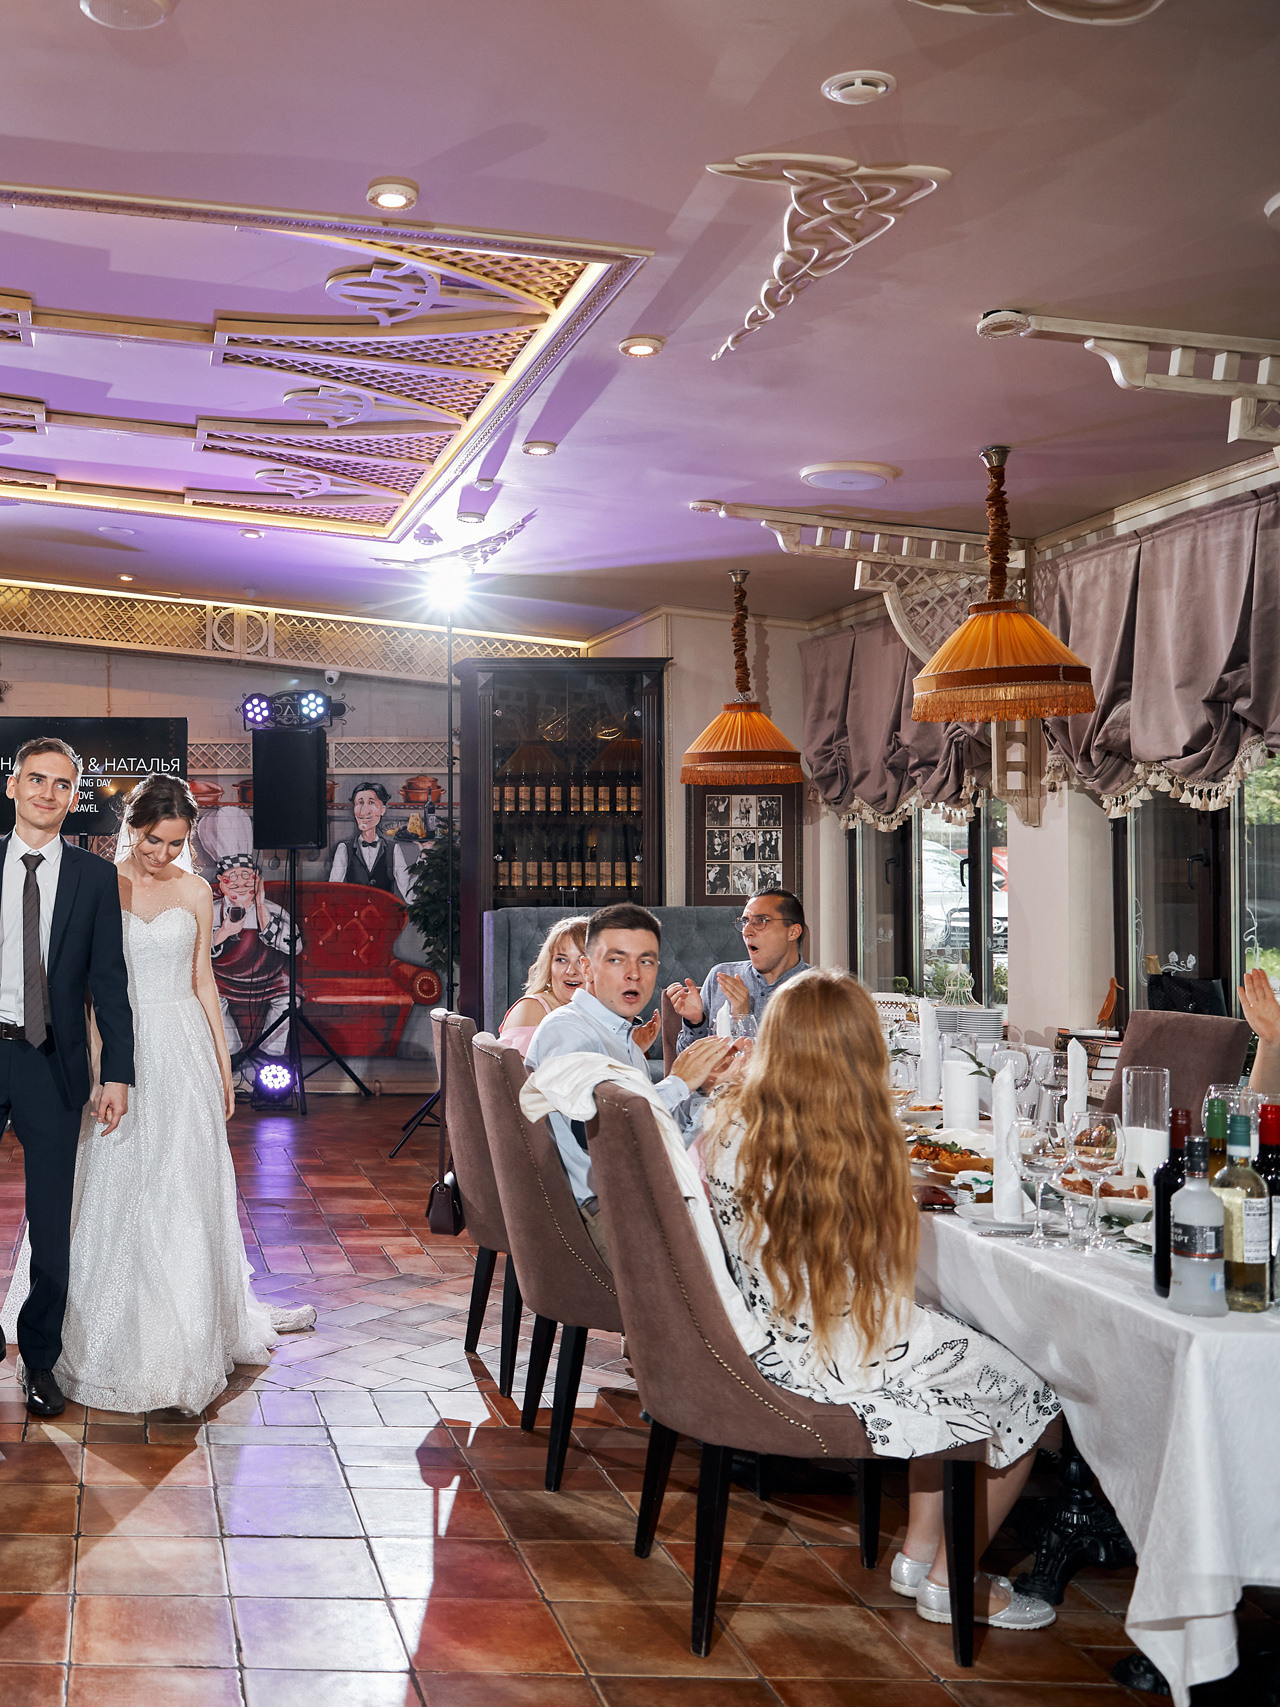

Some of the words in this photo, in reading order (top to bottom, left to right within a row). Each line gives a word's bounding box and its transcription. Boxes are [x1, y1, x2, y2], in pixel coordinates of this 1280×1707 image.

[88, 757, 100, 771] &
[105, 757, 180, 772] НАТАЛЬЯ
[96, 778, 112, 788] DAY
[78, 791, 94, 800] OVE
[75, 804, 99, 813] RAVEL
